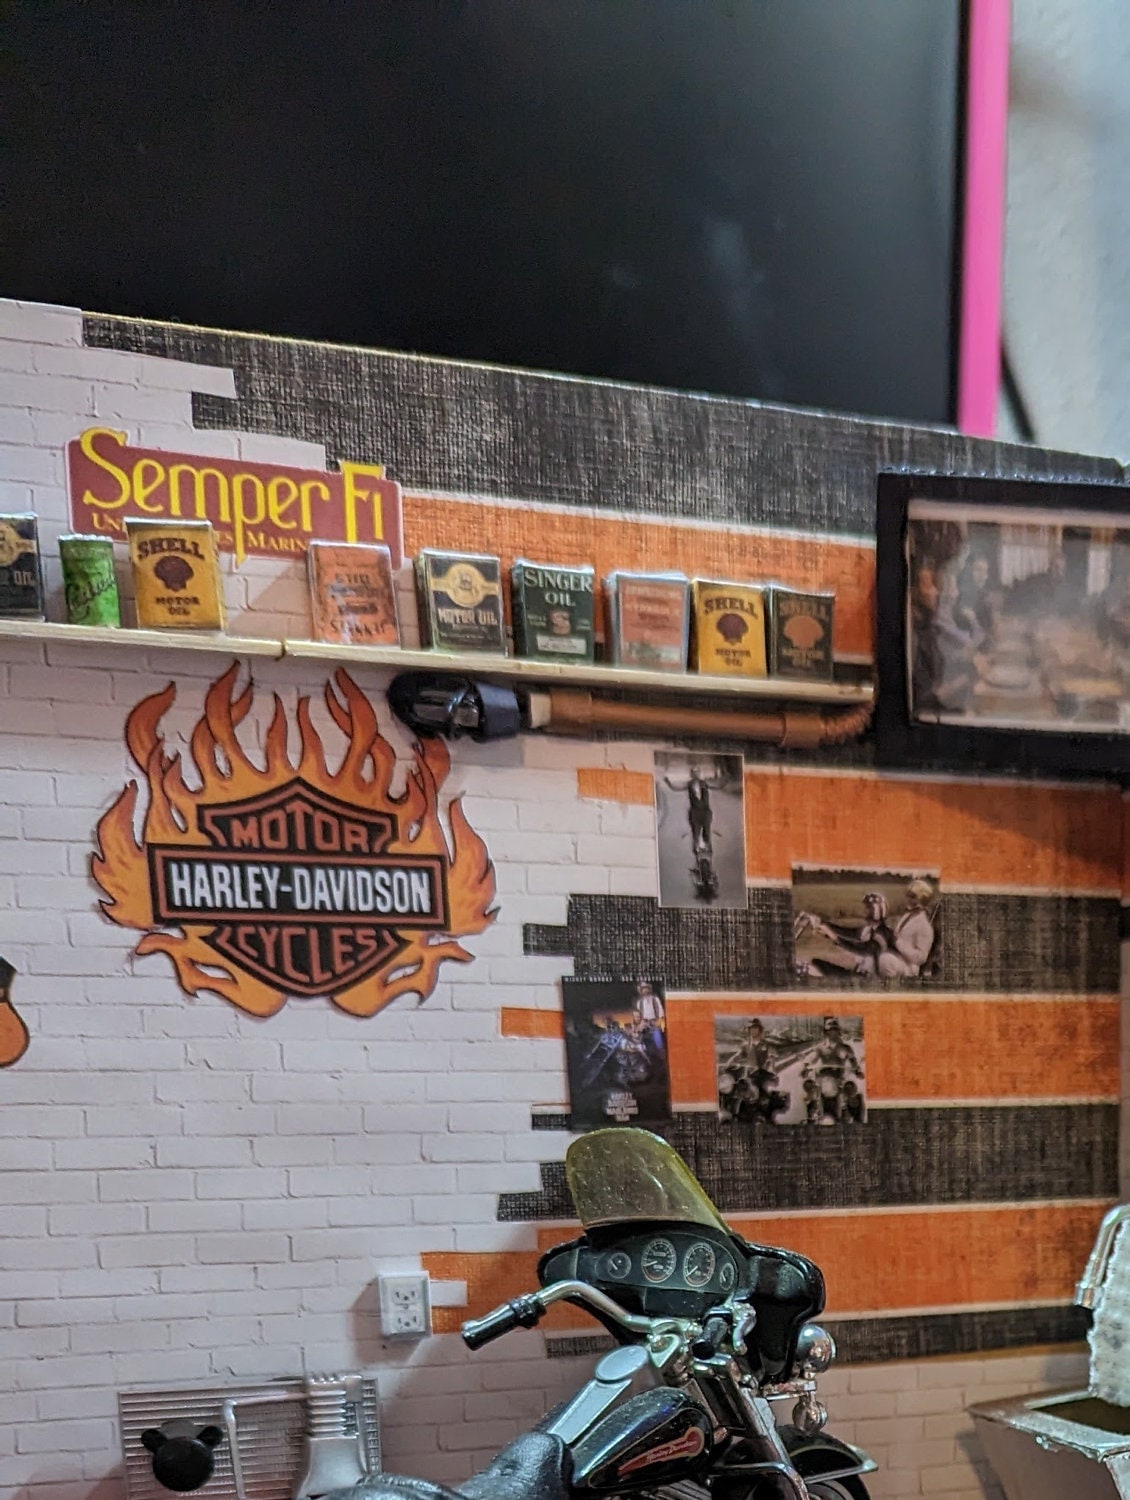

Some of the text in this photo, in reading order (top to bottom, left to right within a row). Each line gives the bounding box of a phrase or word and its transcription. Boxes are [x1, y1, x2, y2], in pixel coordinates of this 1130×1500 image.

[81, 427, 384, 567] Semper Fi
[138, 537, 205, 560] SHELL
[247, 530, 309, 551] MARIN
[524, 568, 592, 593] SINGER
[544, 592, 576, 606] OIL
[704, 597, 758, 620] SHELL
[478, 610, 498, 626] OIL
[231, 801, 370, 853] MOTOR
[171, 862, 431, 914] HARLEY-DAVIDSON
[238, 925, 377, 983] CYCLES
